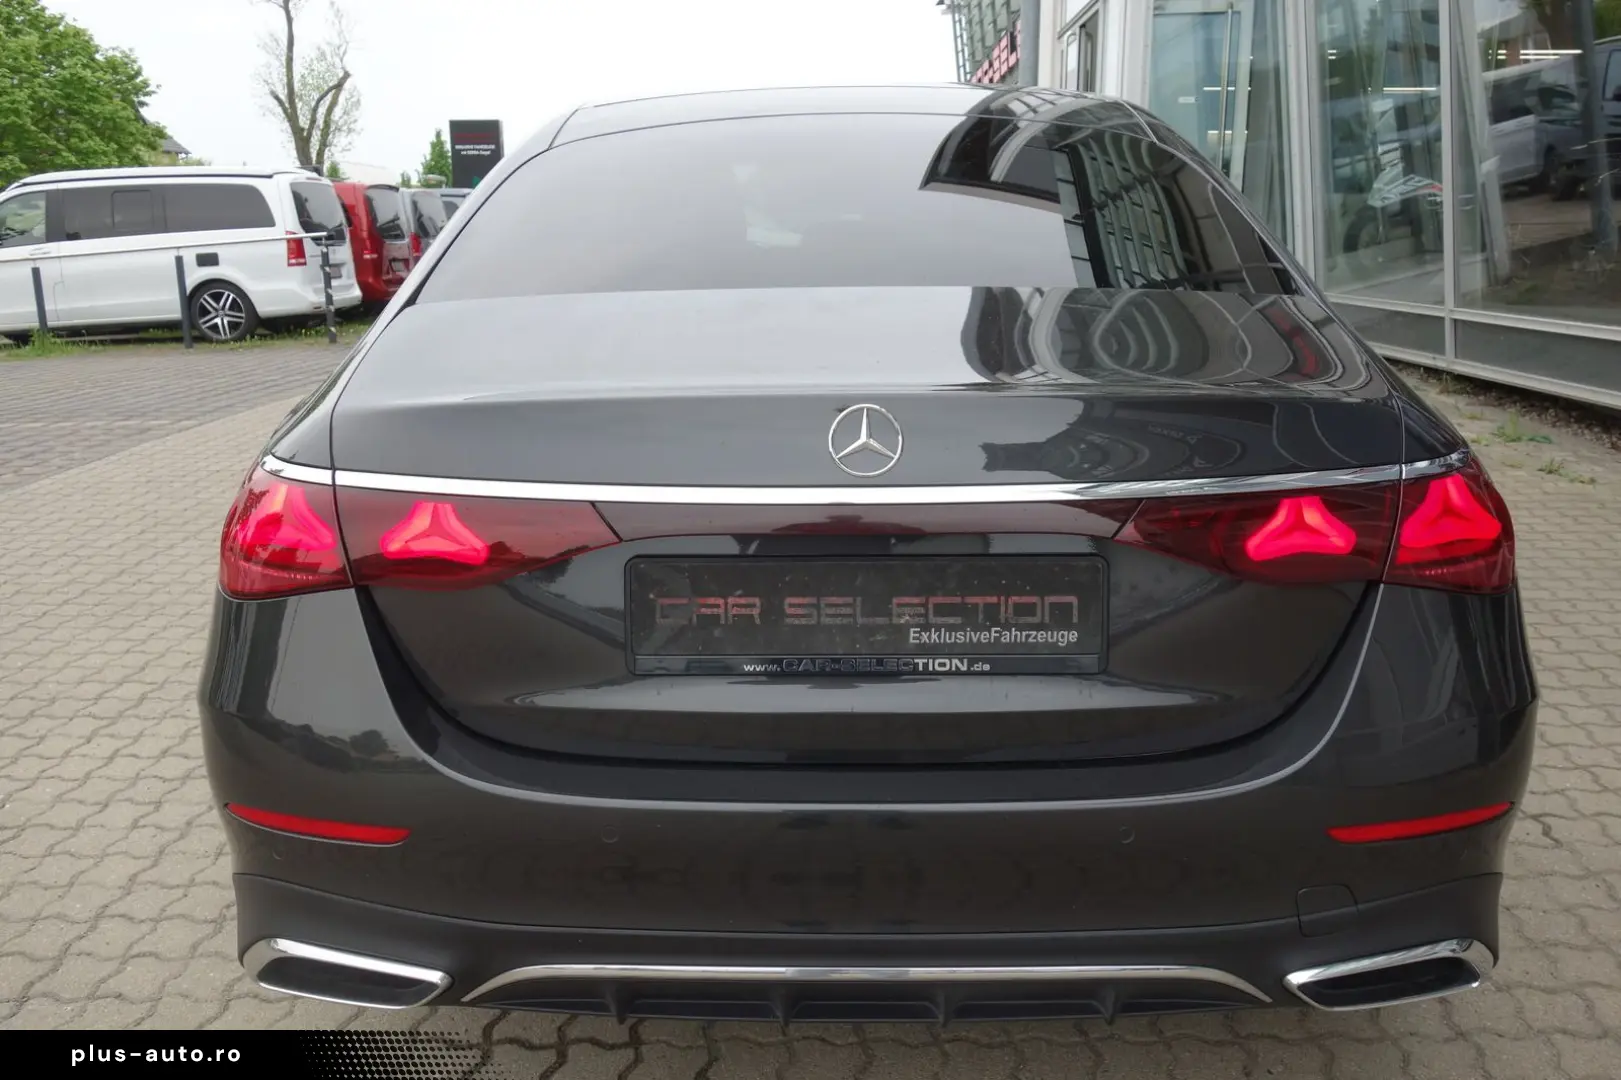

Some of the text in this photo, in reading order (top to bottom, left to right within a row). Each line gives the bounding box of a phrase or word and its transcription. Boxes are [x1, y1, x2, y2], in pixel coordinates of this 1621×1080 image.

[656, 596, 1078, 625] CAR SELECTION
[909, 627, 1078, 646] ExklusiveFahrzeuge
